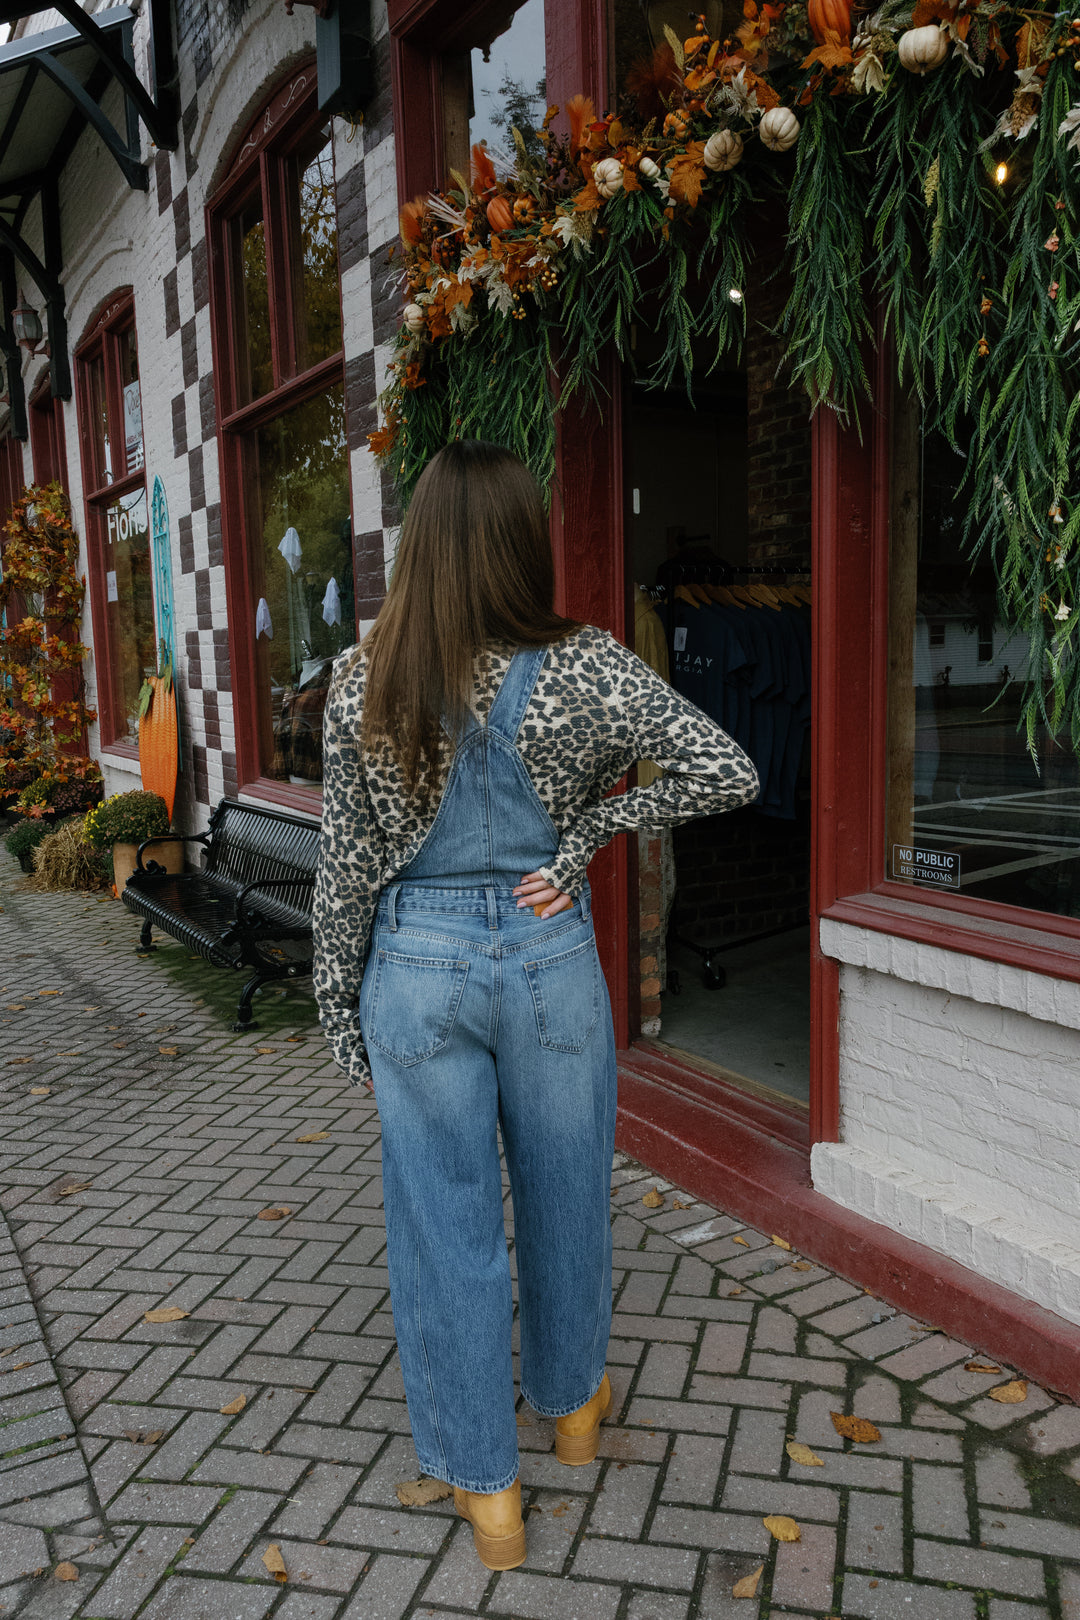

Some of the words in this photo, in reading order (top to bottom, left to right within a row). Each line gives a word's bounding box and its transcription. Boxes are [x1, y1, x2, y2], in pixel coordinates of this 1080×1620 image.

[899, 848, 913, 861] NO
[916, 851, 954, 869] PUBLIC
[900, 865, 953, 883] RESTROOMS
